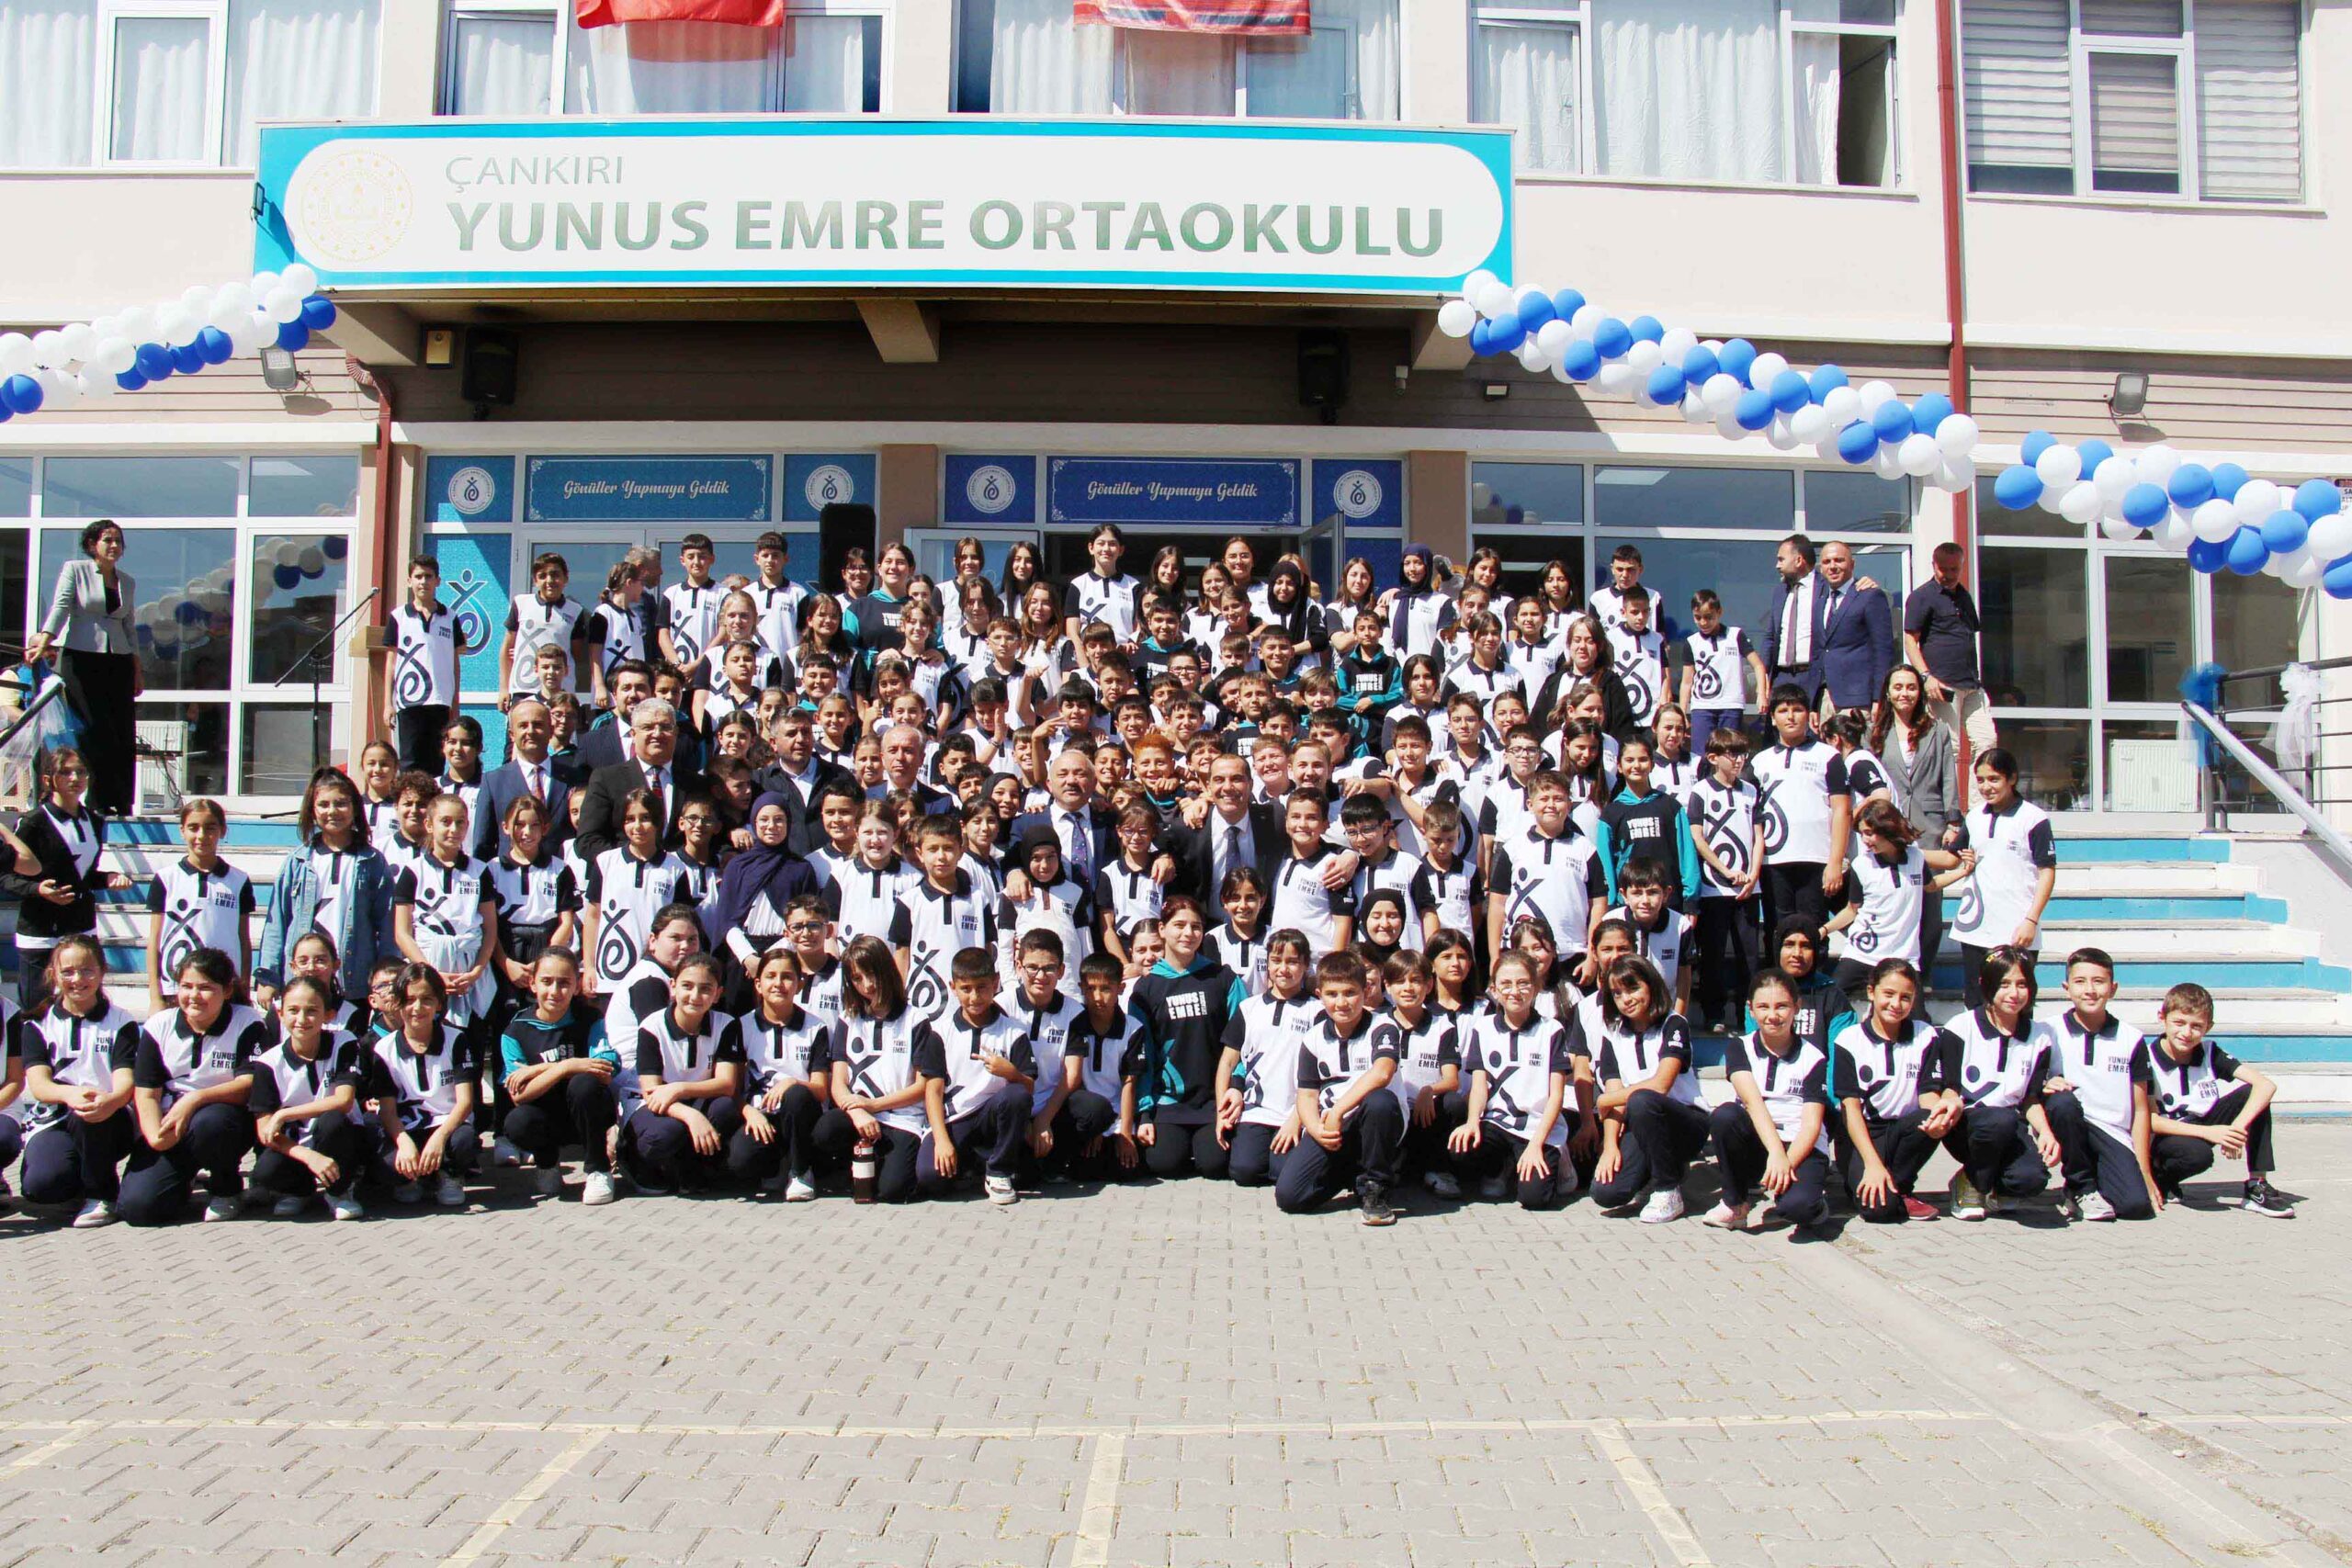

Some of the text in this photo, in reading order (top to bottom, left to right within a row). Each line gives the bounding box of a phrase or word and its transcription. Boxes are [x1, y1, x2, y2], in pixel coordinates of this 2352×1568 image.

[446, 155, 623, 194] ÇANKIRI
[447, 200, 709, 252] YUNUS
[736, 198, 945, 251] EMRE
[969, 198, 1442, 257] ORTAOKULU
[564, 479, 729, 500] Gönüller Yapmaya Geldik
[1088, 480, 1258, 502] Gönüller Yapmaya Geldik
[1165, 991, 1200, 1008] YUNUS
[1168, 1002, 1202, 1021] EMRE
